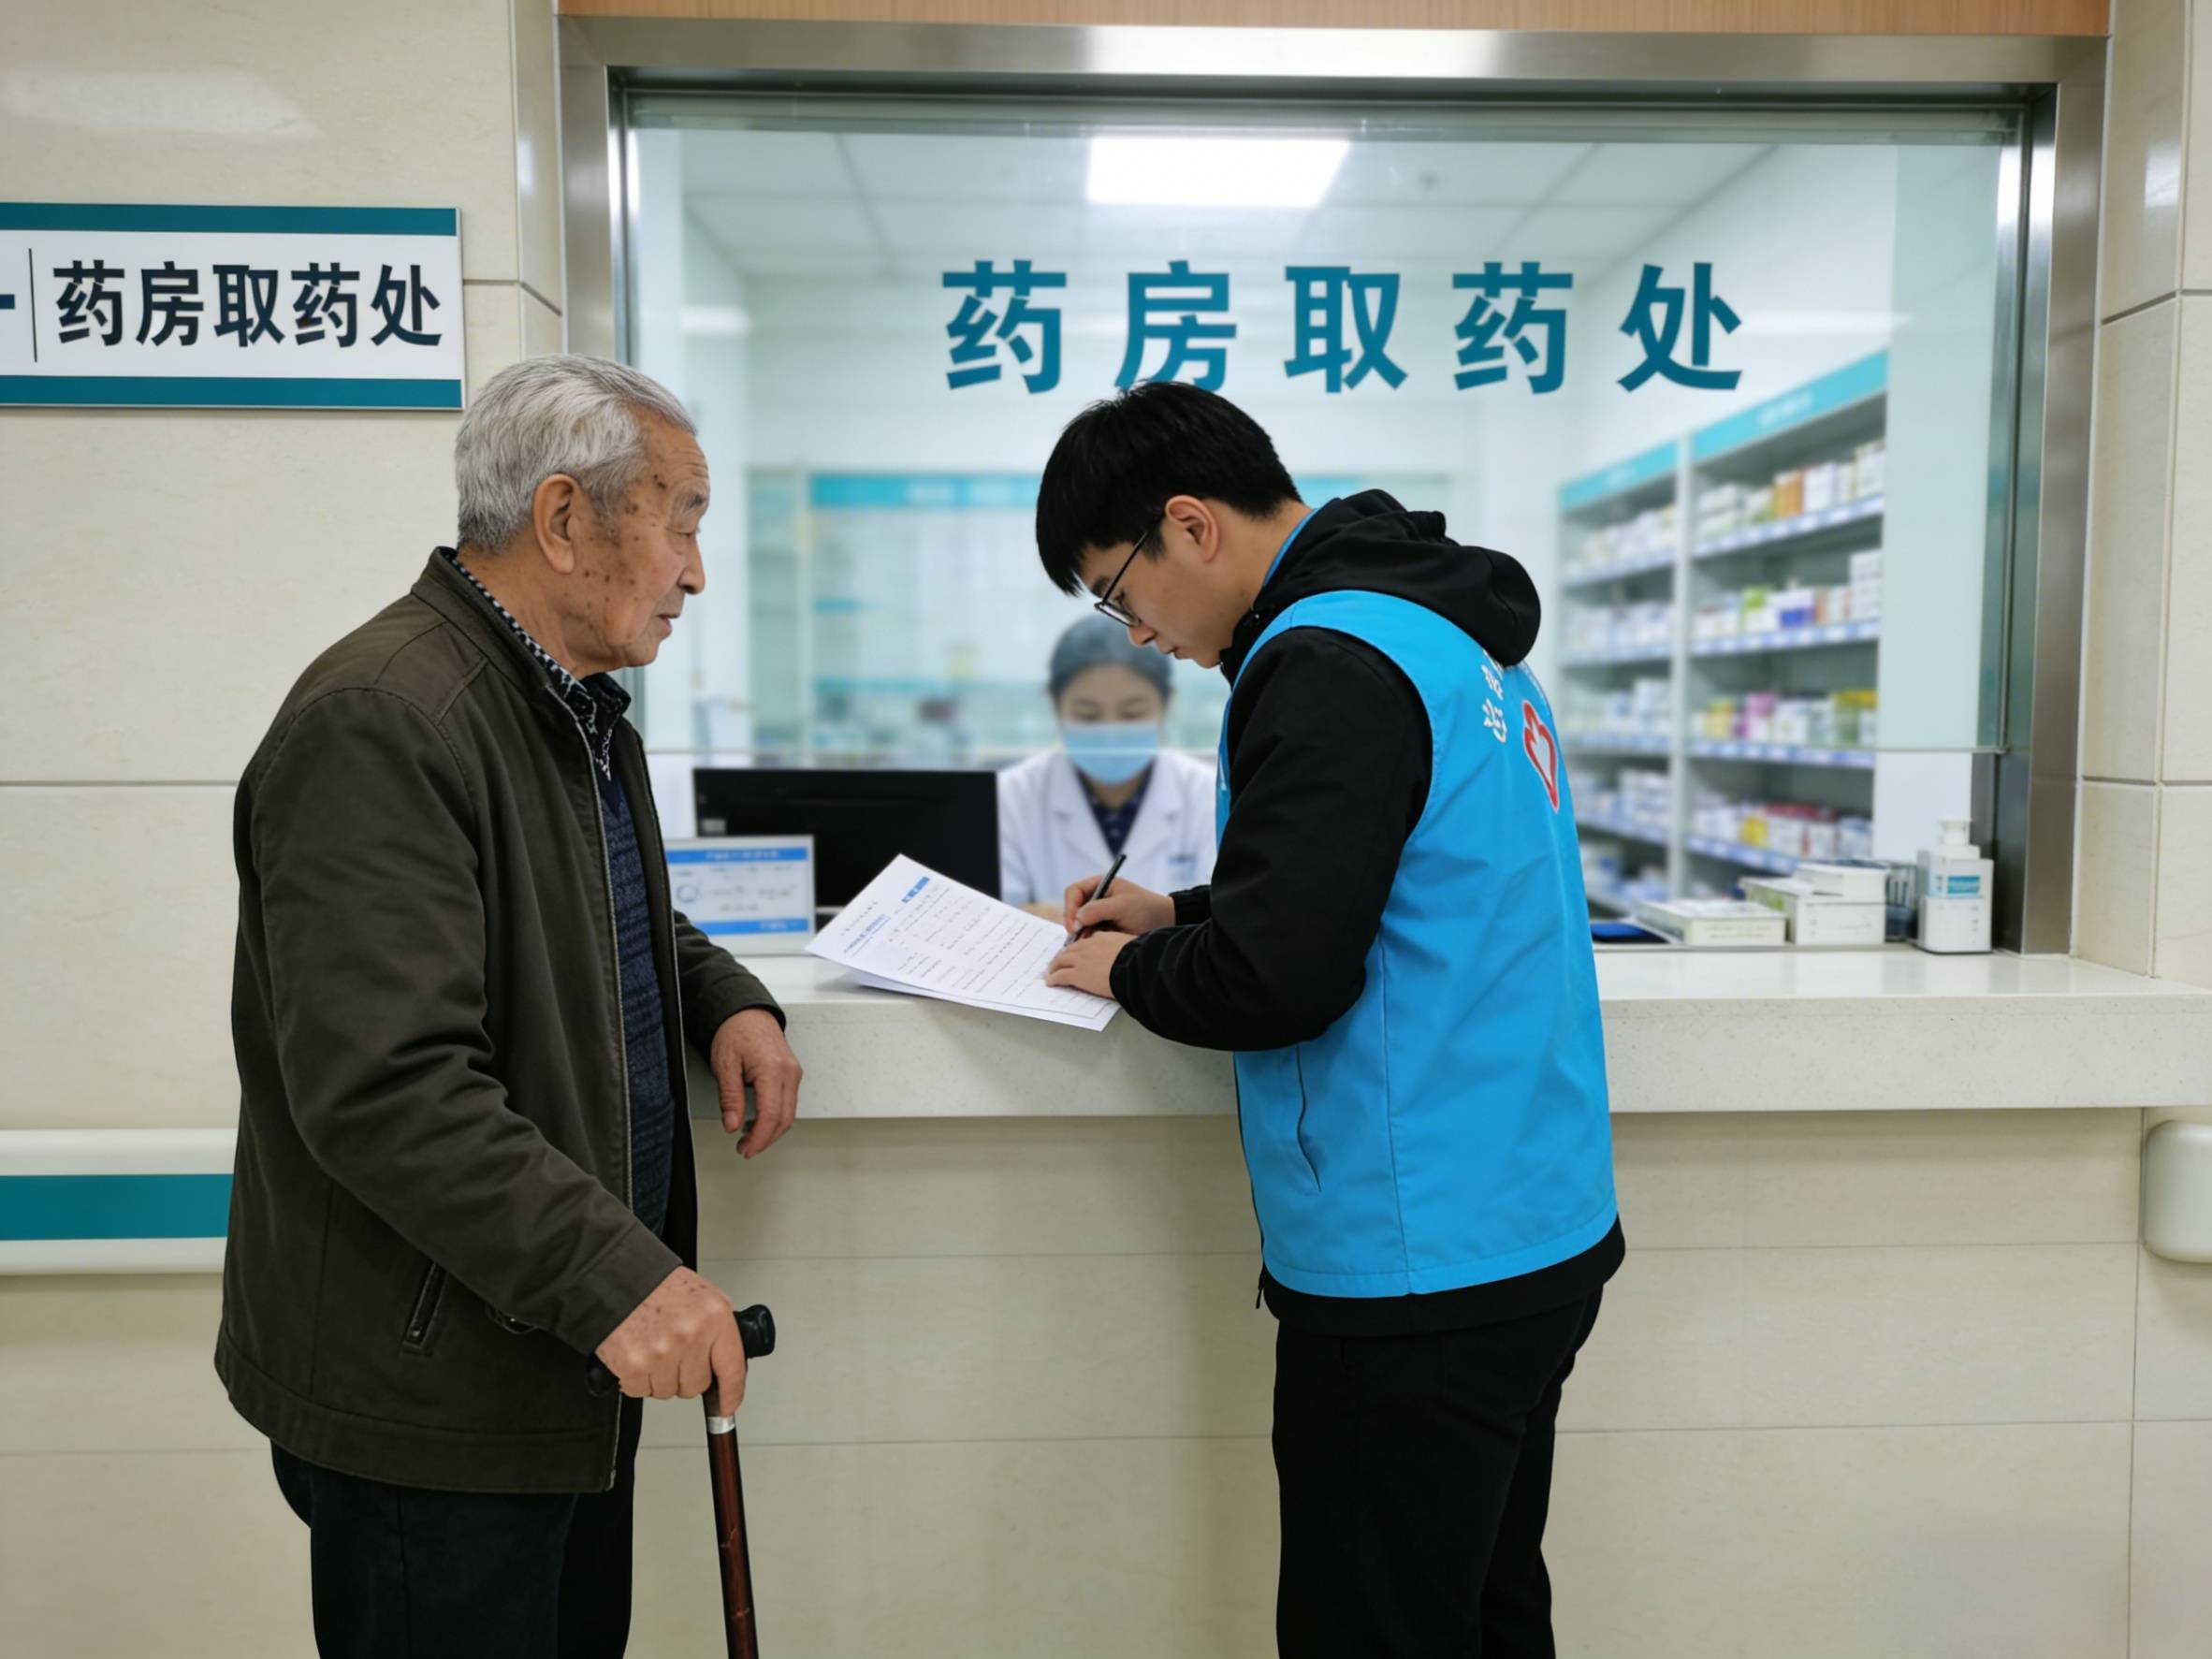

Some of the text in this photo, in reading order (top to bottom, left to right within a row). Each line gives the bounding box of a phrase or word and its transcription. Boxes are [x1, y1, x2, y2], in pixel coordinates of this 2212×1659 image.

[52, 258, 442, 348] 药房取药处
[941, 259, 1744, 394] 药房取药处
